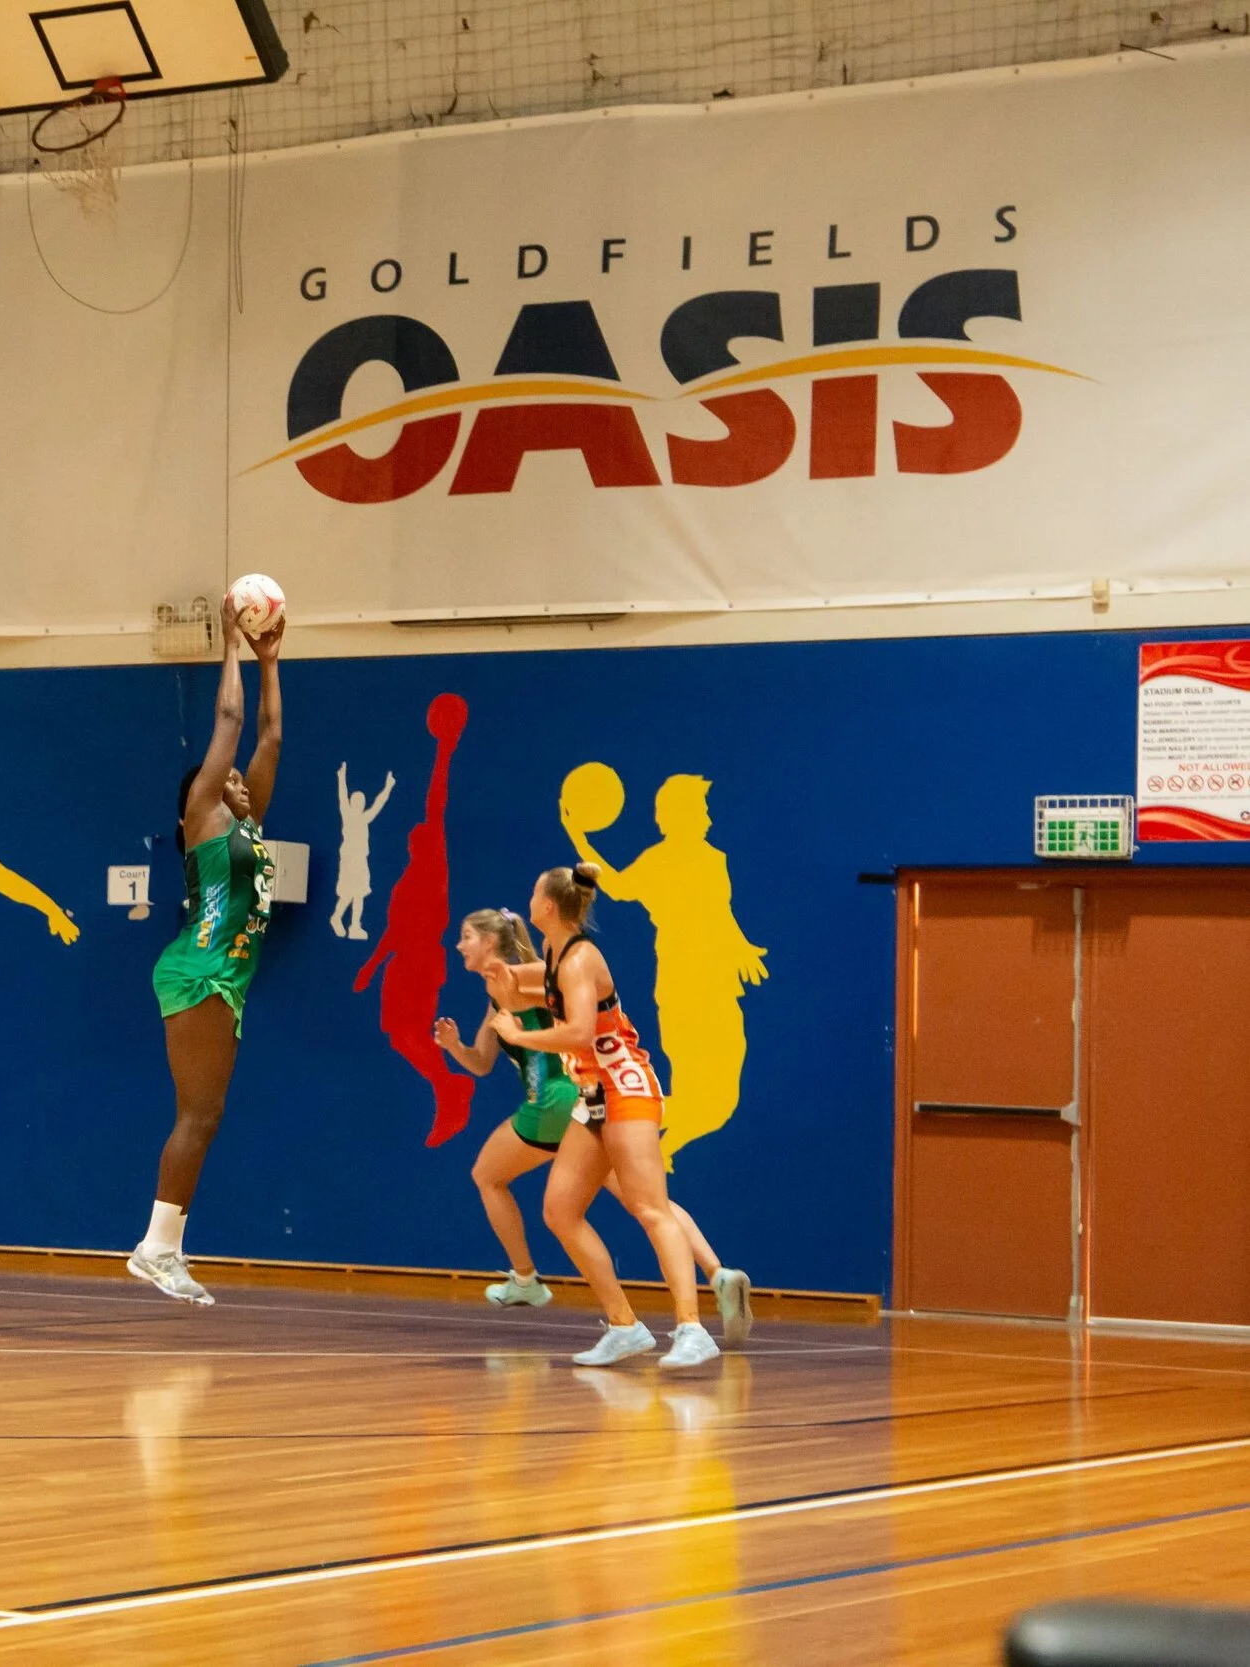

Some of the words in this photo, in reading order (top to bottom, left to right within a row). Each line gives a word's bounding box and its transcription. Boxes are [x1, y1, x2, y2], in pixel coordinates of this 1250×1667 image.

[299, 204, 1018, 301] GOLDFIELDS
[287, 268, 1023, 505] OASIS
[1143, 687, 1182, 696] STADIUM
[1184, 686, 1214, 694] RULES
[1178, 763, 1199, 772] NOT
[119, 870, 146, 879] Court
[128, 881, 137, 901] 1
